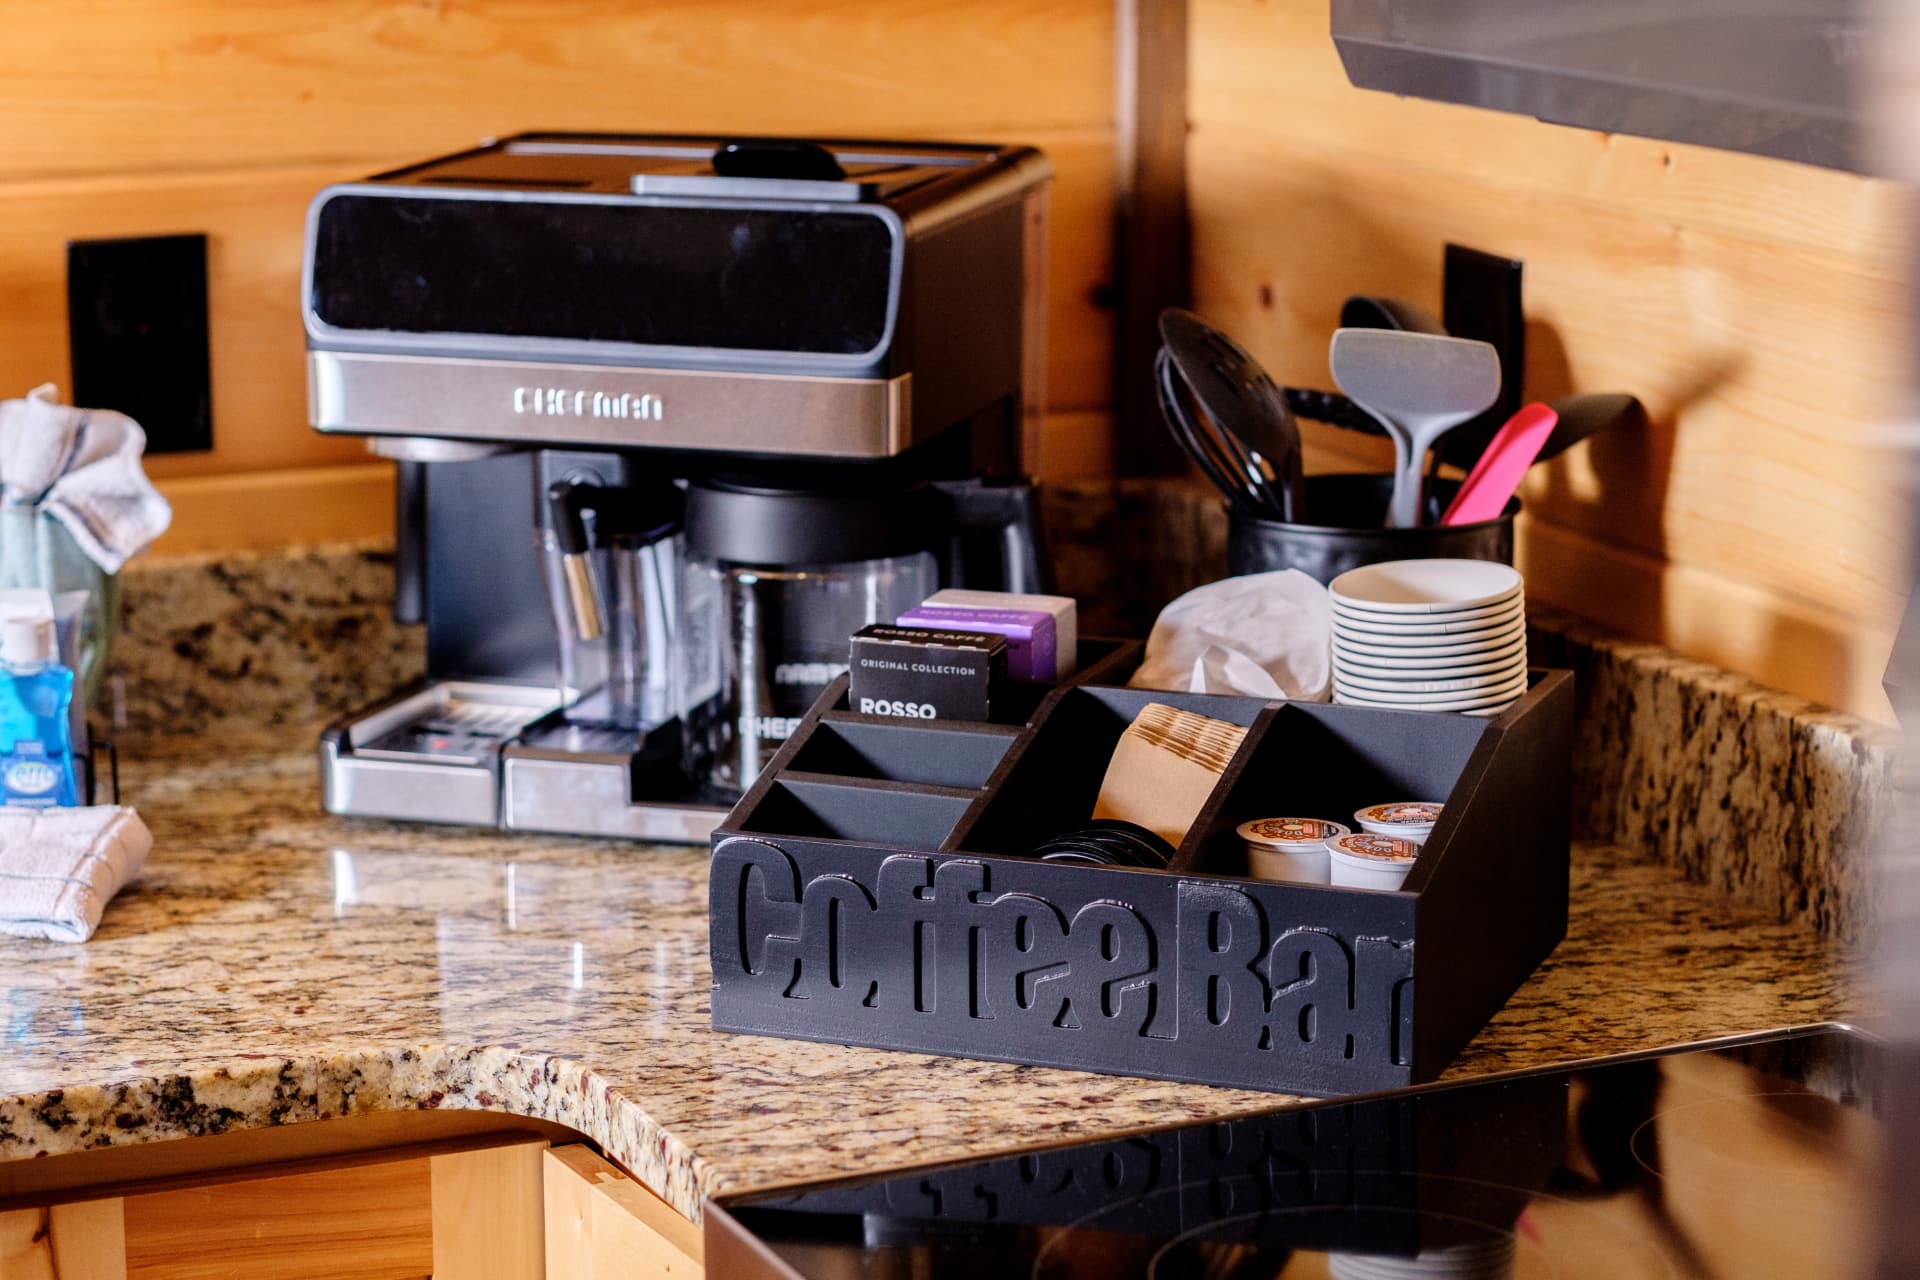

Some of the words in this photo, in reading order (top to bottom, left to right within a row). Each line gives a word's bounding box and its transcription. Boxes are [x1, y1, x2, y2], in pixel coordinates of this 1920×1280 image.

[873, 628, 929, 638] ROSSO
[861, 658, 908, 671] ORIGINAL
[911, 663, 976, 676] COLLECTION
[860, 697, 937, 720] ROSSO
[711, 837, 1177, 1040] Coffee
[1178, 881, 1416, 1066] Bar
